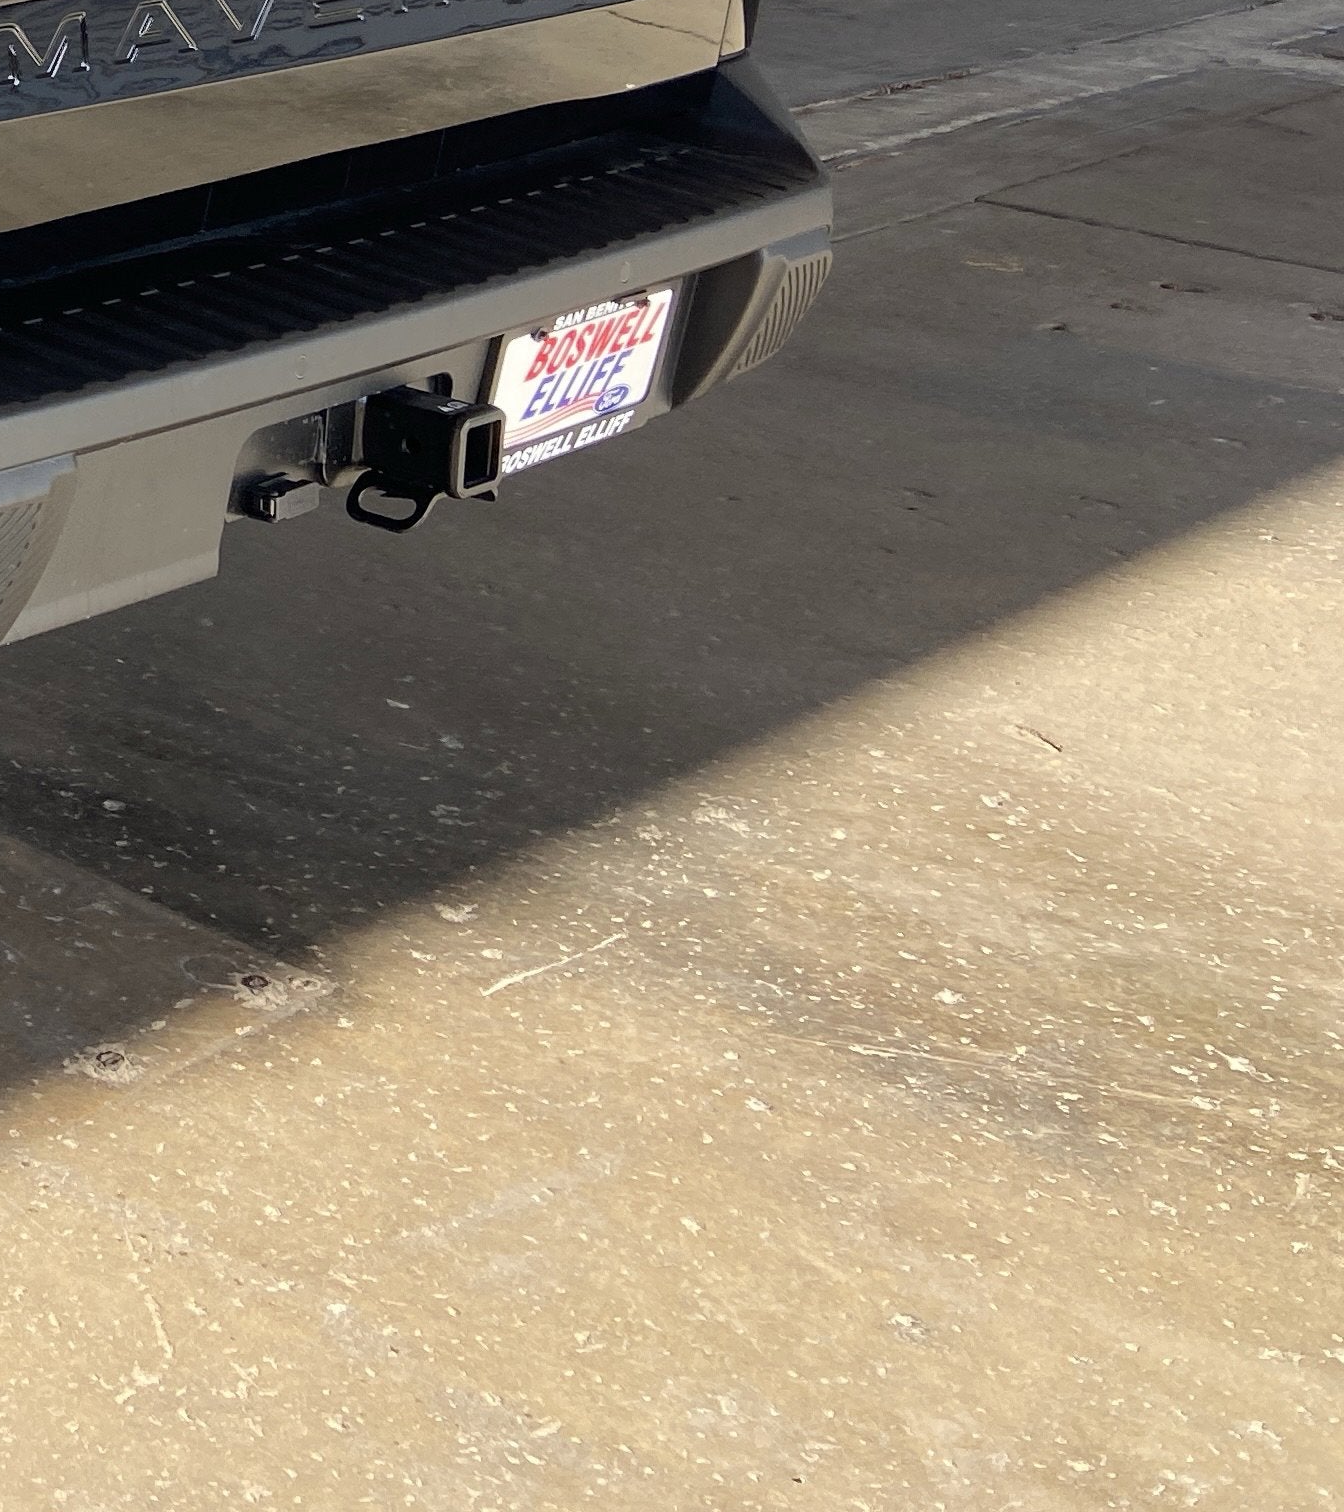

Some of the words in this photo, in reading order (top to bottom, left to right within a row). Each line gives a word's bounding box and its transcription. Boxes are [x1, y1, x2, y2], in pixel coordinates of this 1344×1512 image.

[523, 302, 666, 383] BOSWELL
[553, 308, 586, 331] SAN
[585, 300, 636, 321] BEN
[519, 349, 635, 422] ELLIFF
[574, 409, 635, 449] ELLIFF
